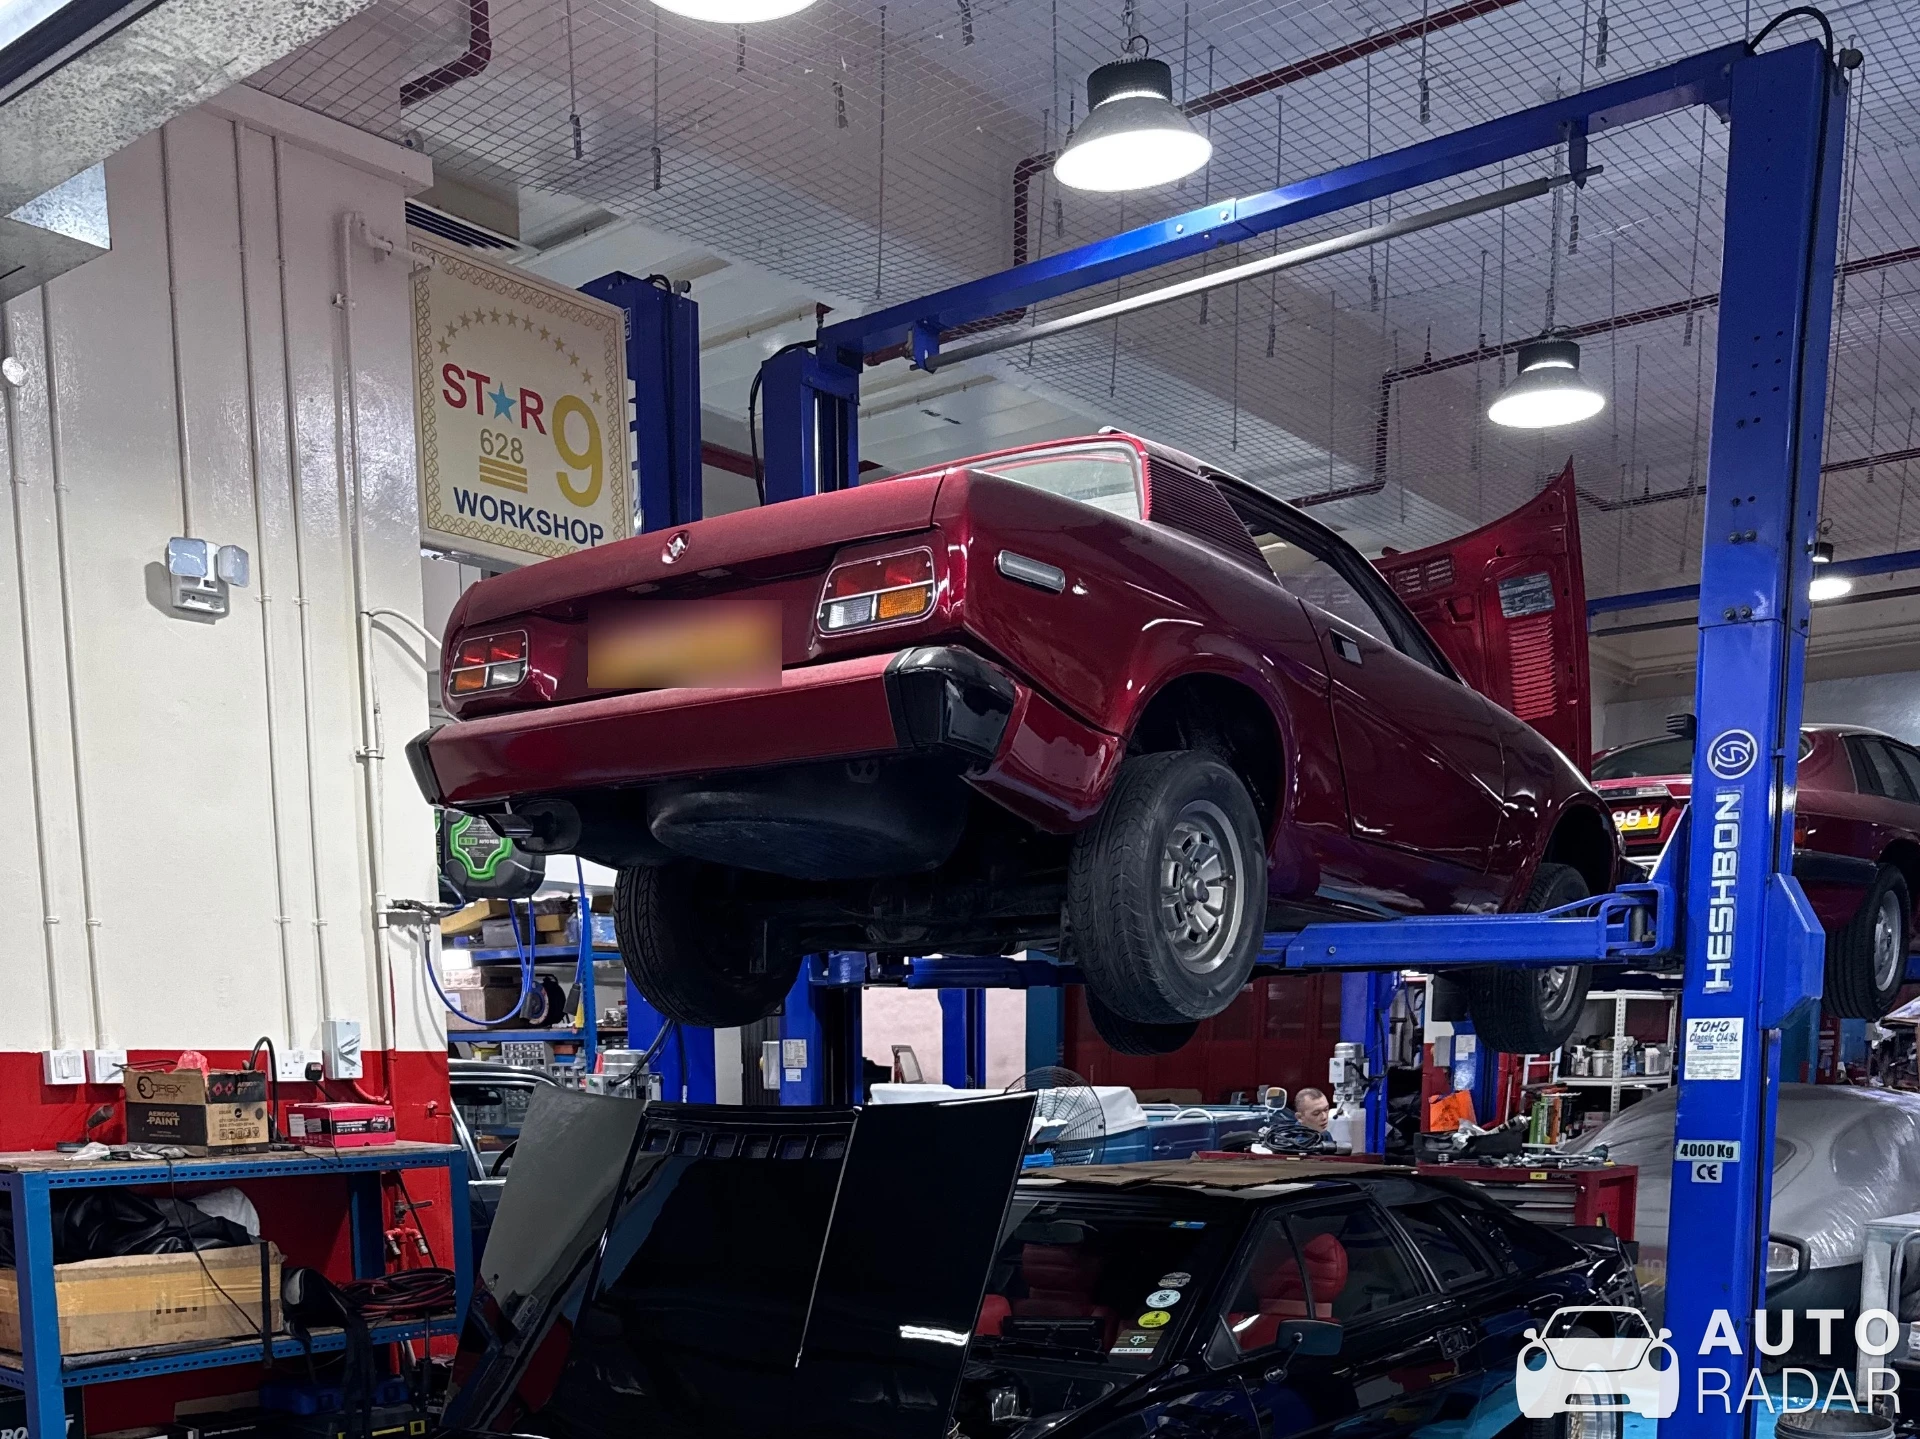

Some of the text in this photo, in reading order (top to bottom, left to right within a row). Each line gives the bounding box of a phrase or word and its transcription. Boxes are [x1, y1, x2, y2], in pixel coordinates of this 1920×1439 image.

[480, 428, 524, 464] 628
[552, 395, 603, 508] 9
[453, 487, 604, 547] WORKSHOP
[1705, 792, 1742, 989] HESHBON
[1693, 1021, 1730, 1032] TOHO
[1690, 1032, 1714, 1043] Classic
[147, 1117, 180, 1126] PAINT
[148, 1110, 179, 1118] AEROSOL
[1680, 1144, 1734, 1158] 4000 Kg
[1697, 1164, 1718, 1180] CE
